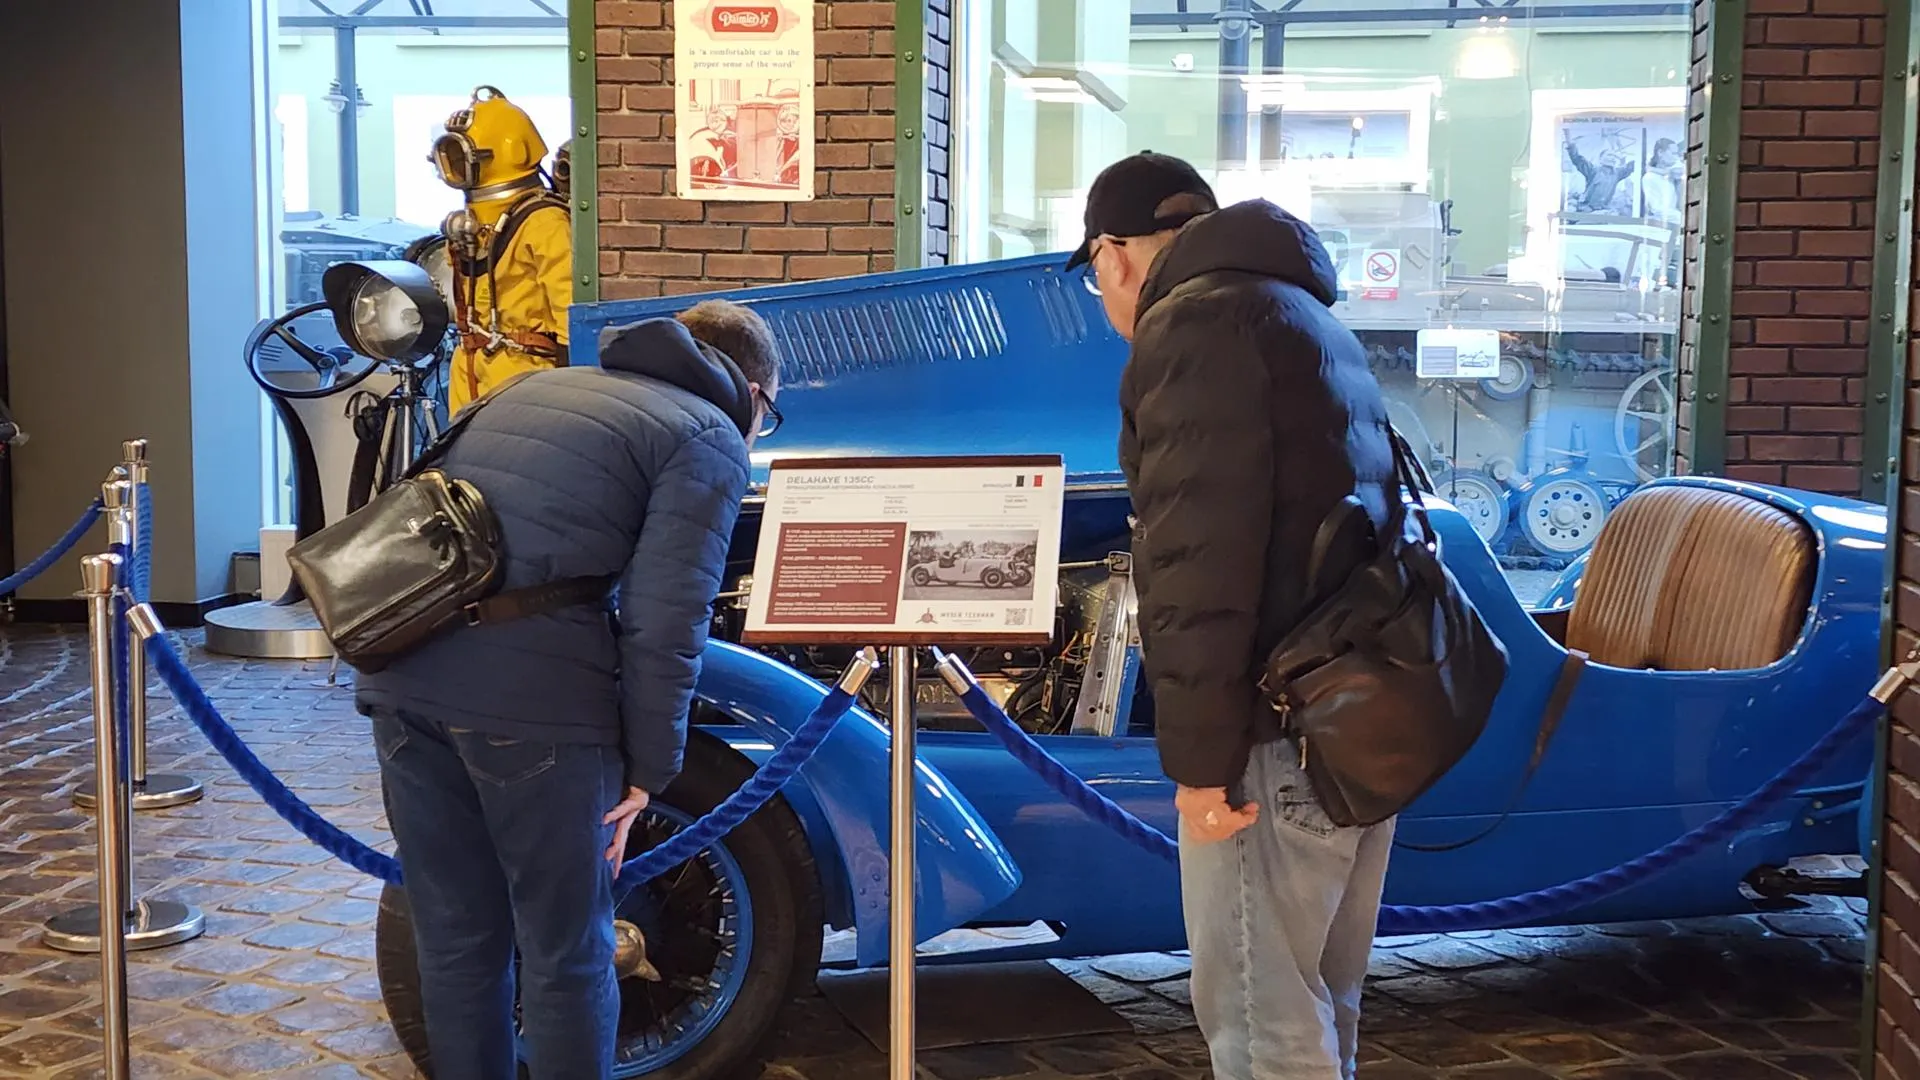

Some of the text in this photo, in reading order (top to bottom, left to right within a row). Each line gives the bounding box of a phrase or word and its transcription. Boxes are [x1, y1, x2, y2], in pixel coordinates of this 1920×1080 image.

[689, 48, 696, 56] is
[710, 48, 756, 56] comfortable
[775, 48, 784, 56] in
[788, 48, 800, 56] the
[693, 61, 719, 69] proper
[746, 60, 754, 68] of
[757, 60, 768, 68] the
[786, 475, 875, 484] DELAHAYE 135CC
